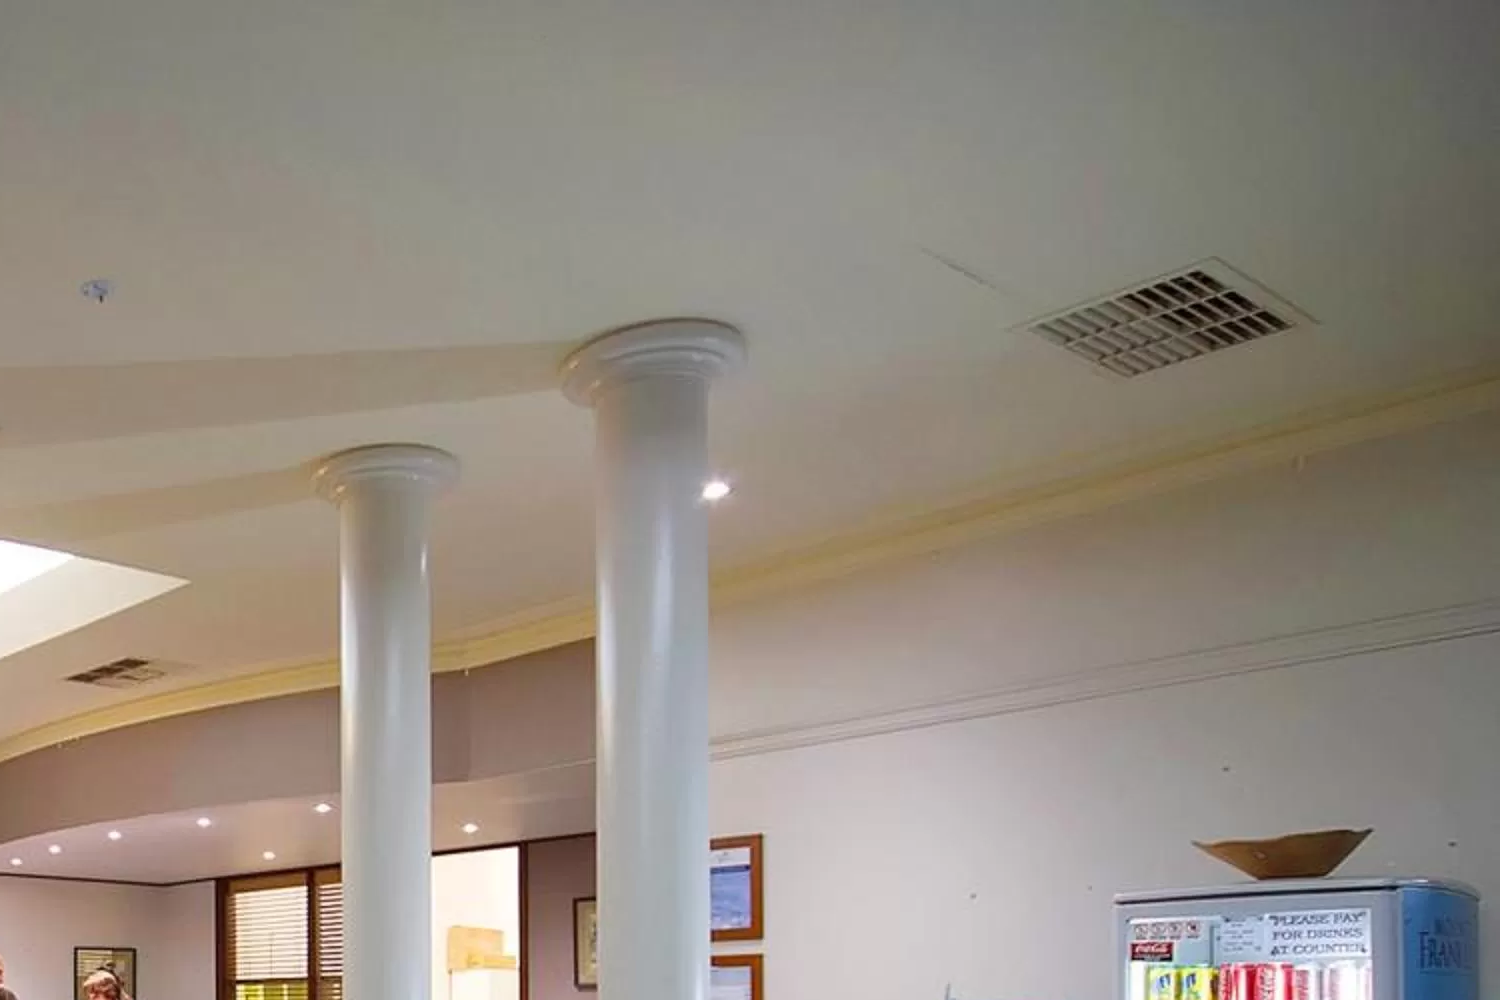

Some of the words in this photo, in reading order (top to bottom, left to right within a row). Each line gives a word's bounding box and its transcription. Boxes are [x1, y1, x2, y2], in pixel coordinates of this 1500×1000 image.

[1333, 912, 1361, 923] PAY
[1272, 931, 1302, 940] FOR
[1272, 945, 1289, 955] AT
